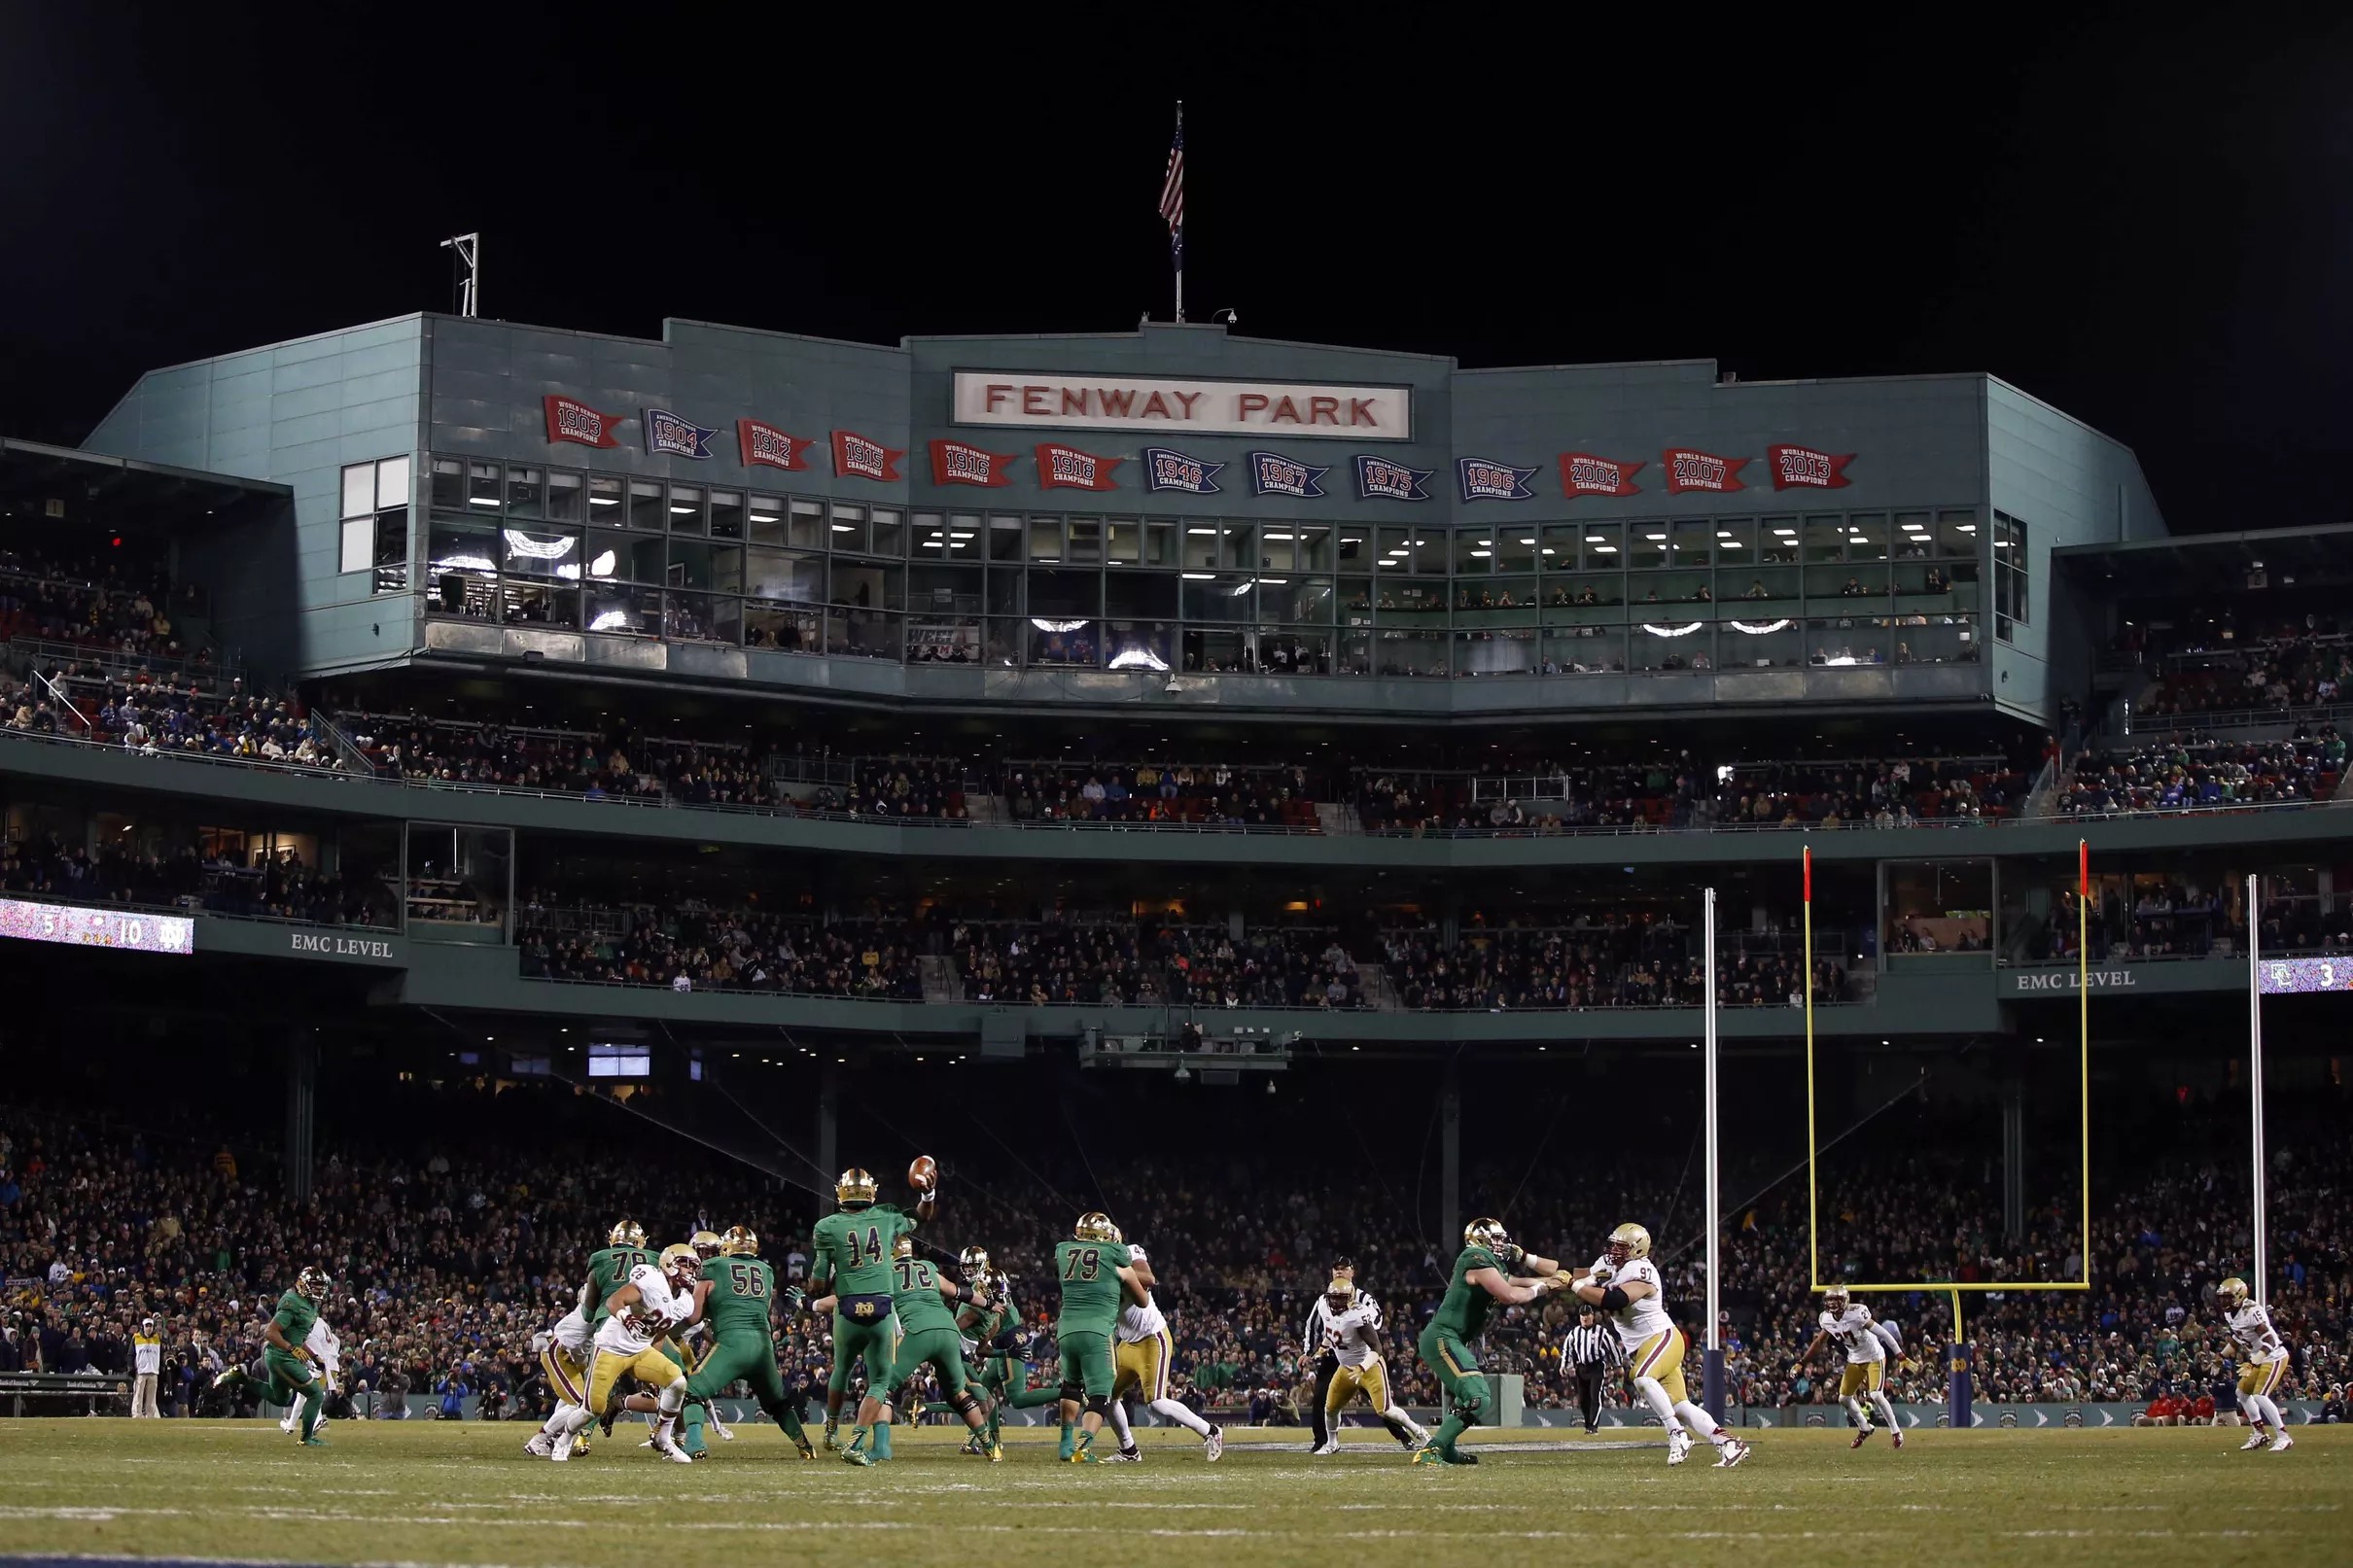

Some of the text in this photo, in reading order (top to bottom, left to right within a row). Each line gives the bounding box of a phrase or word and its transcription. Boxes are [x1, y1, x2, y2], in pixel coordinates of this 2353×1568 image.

[558, 401, 600, 420] WORLD SERIES
[986, 385, 1378, 427] FENWAY PARK
[558, 408, 602, 437] 1903
[656, 414, 696, 432] AMERICAN LEAGUE
[561, 427, 598, 443] CHAMPIONS
[655, 420, 698, 450] 1904
[752, 425, 790, 444] WORLD SERIES
[658, 439, 695, 456] CHAMPIONS
[753, 432, 790, 460] 1912
[844, 436, 884, 454] WORLD SERIES
[944, 444, 990, 461] WORLD SERIES
[754, 450, 790, 467] CHAMPIONS
[846, 442, 883, 470] 1915
[946, 451, 990, 476] 1916
[1050, 448, 1096, 465] WORLD SERIES
[1157, 453, 1201, 469] AMERICAN LEAGUE
[1262, 458, 1306, 471] AMERICAN LEAGUE
[1701, 456, 1723, 466] SERIES
[1806, 451, 1829, 462] SERIES
[847, 461, 882, 477] CHAMPIONS
[1051, 455, 1095, 479] 1918
[1156, 459, 1203, 484] 1946
[1366, 460, 1410, 475] AMERICAN LEAGUE
[1494, 466, 1513, 475] LEAGUE
[1596, 461, 1618, 470] SERIES
[1673, 459, 1726, 483] 2007
[1780, 455, 1831, 478] 2013
[947, 470, 988, 483] CHAMPIONS
[1053, 473, 1094, 486] CHAMPIONS
[1159, 477, 1199, 491] CHAMPIONS
[1260, 463, 1308, 488] 1967
[1366, 466, 1412, 491] 1975
[1468, 468, 1515, 491] 1986
[1570, 464, 1619, 487] 2004
[1679, 478, 1722, 489] CHAMPIONS
[1785, 474, 1828, 486] CHAMPIONS
[1264, 481, 1304, 495] CHAMPIONS
[1369, 484, 1409, 498] CHAMPIONS
[1471, 486, 1512, 497] CHAMPIONS
[1576, 482, 1616, 493] CHAMPIONS
[120, 919, 142, 945] 10
[292, 934, 393, 958] EMC LEVEL
[2017, 971, 2136, 990] EMC LEVEL
[2320, 964, 2334, 987] 3
[846, 1226, 884, 1268] 14
[1063, 1247, 1101, 1281] 79
[630, 1268, 647, 1280] 28
[730, 1263, 766, 1298] 56
[892, 1263, 934, 1291] 72
[1639, 1267, 1652, 1281] 97
